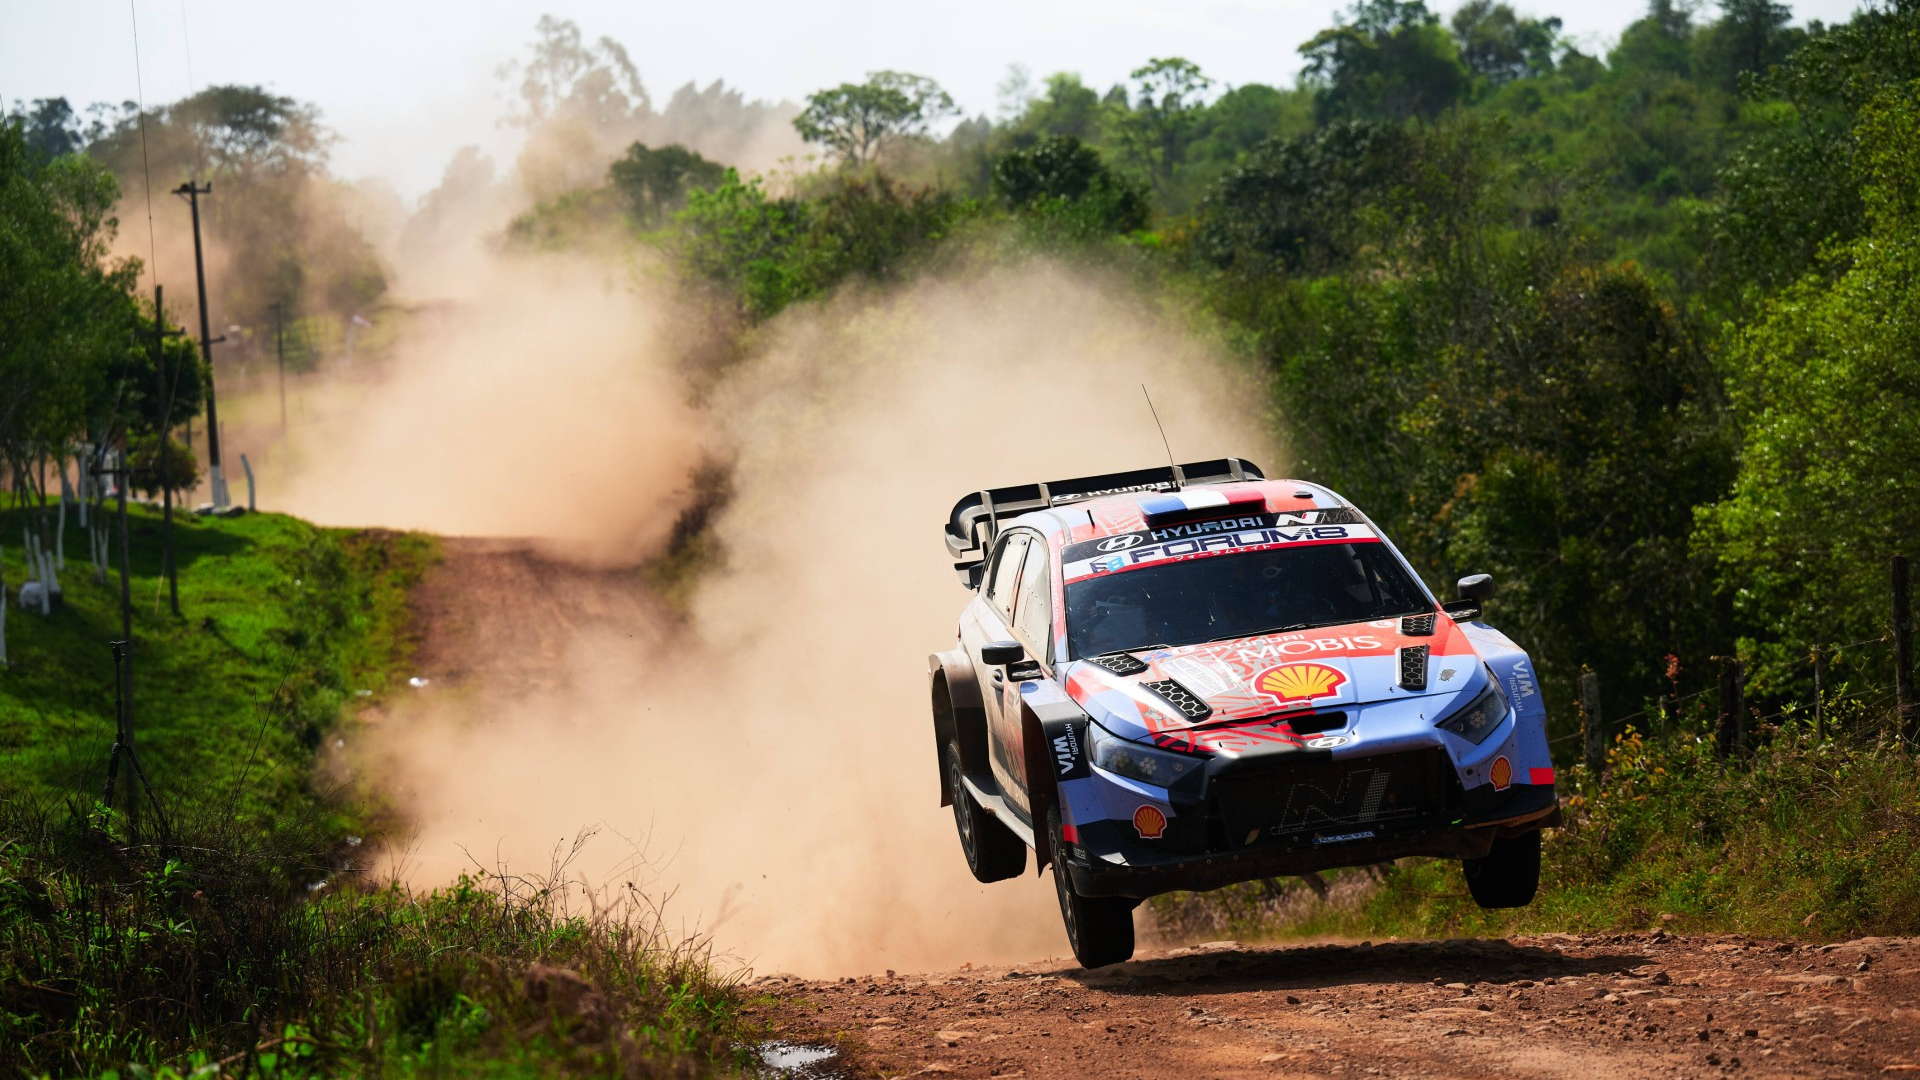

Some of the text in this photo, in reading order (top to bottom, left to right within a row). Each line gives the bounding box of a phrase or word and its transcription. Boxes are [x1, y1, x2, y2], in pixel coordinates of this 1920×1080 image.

[1151, 516, 1264, 541] HYUNDAI
[1129, 526, 1349, 563] FORUM8
[1207, 634, 1305, 651] HYUNDAI
[1237, 635, 1382, 662] MOBIS
[1508, 677, 1524, 712] HYUNDAI
[1065, 723, 1079, 755] HYUNDAI
